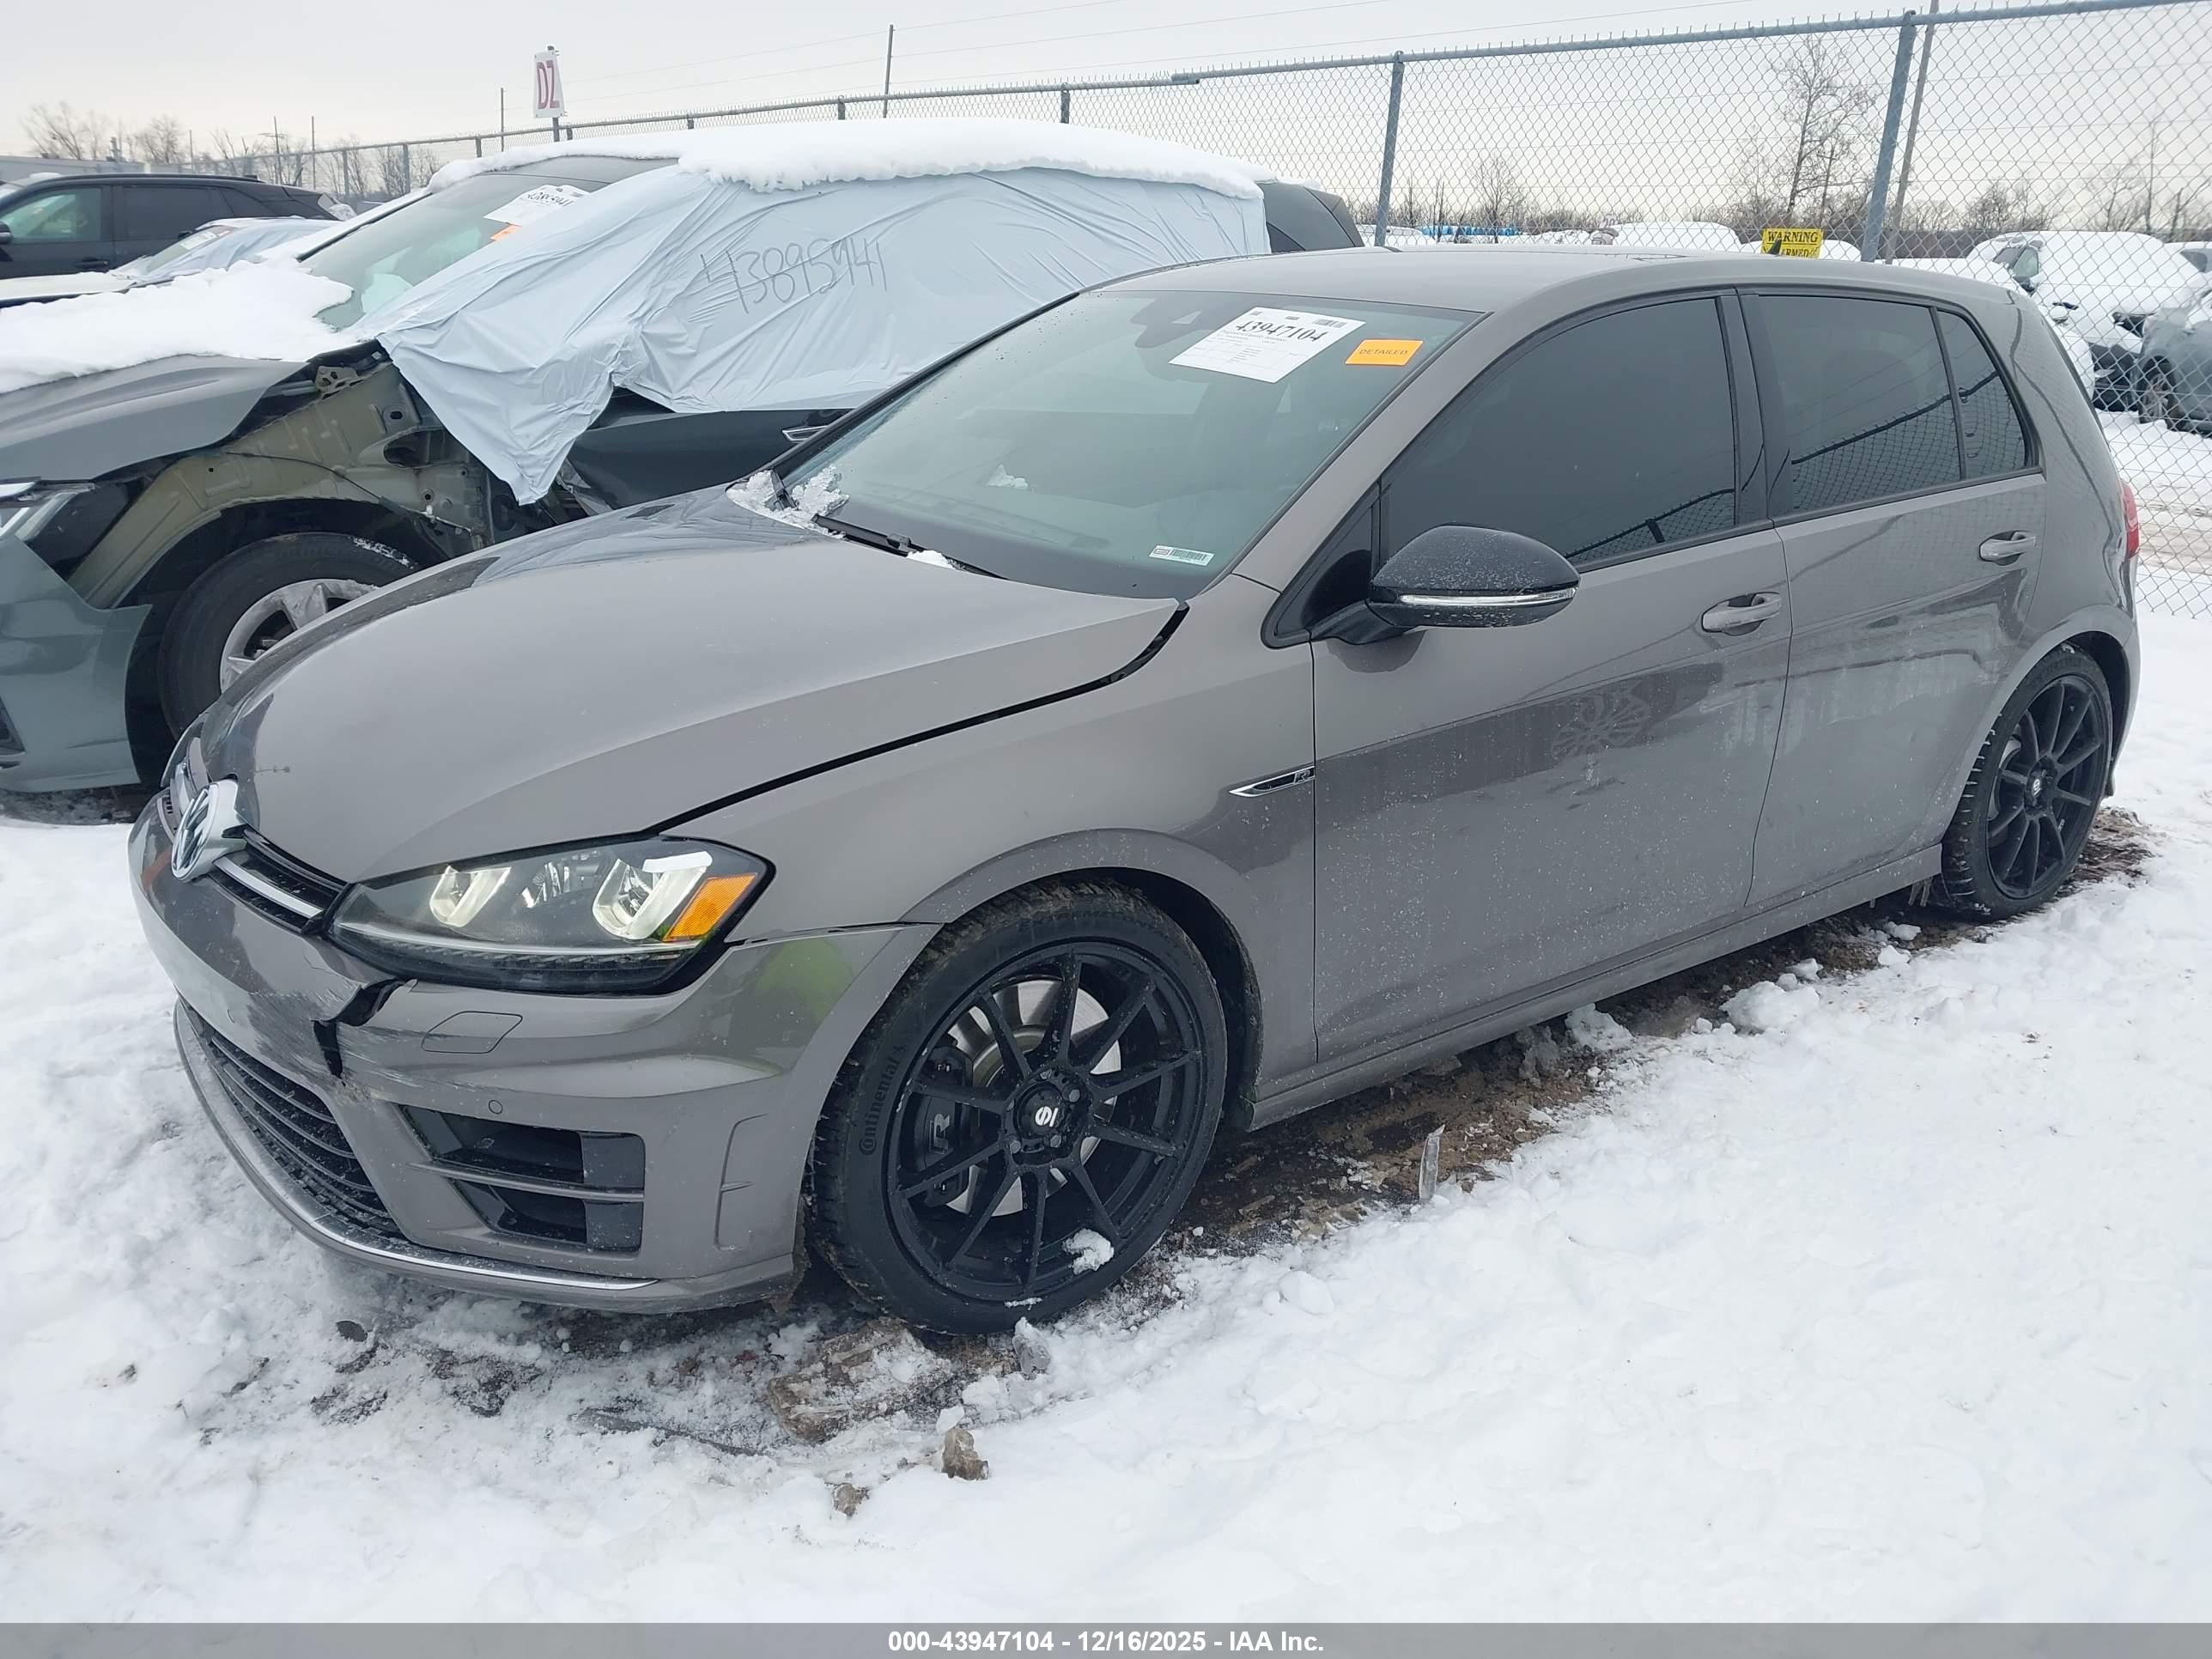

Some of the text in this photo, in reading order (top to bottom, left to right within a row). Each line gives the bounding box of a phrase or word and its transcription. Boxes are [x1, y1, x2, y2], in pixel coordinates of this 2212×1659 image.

[1768, 231, 1818, 242] WARNING
[1237, 321, 1328, 342] 43947104
[859, 1056, 900, 1156] Continental
